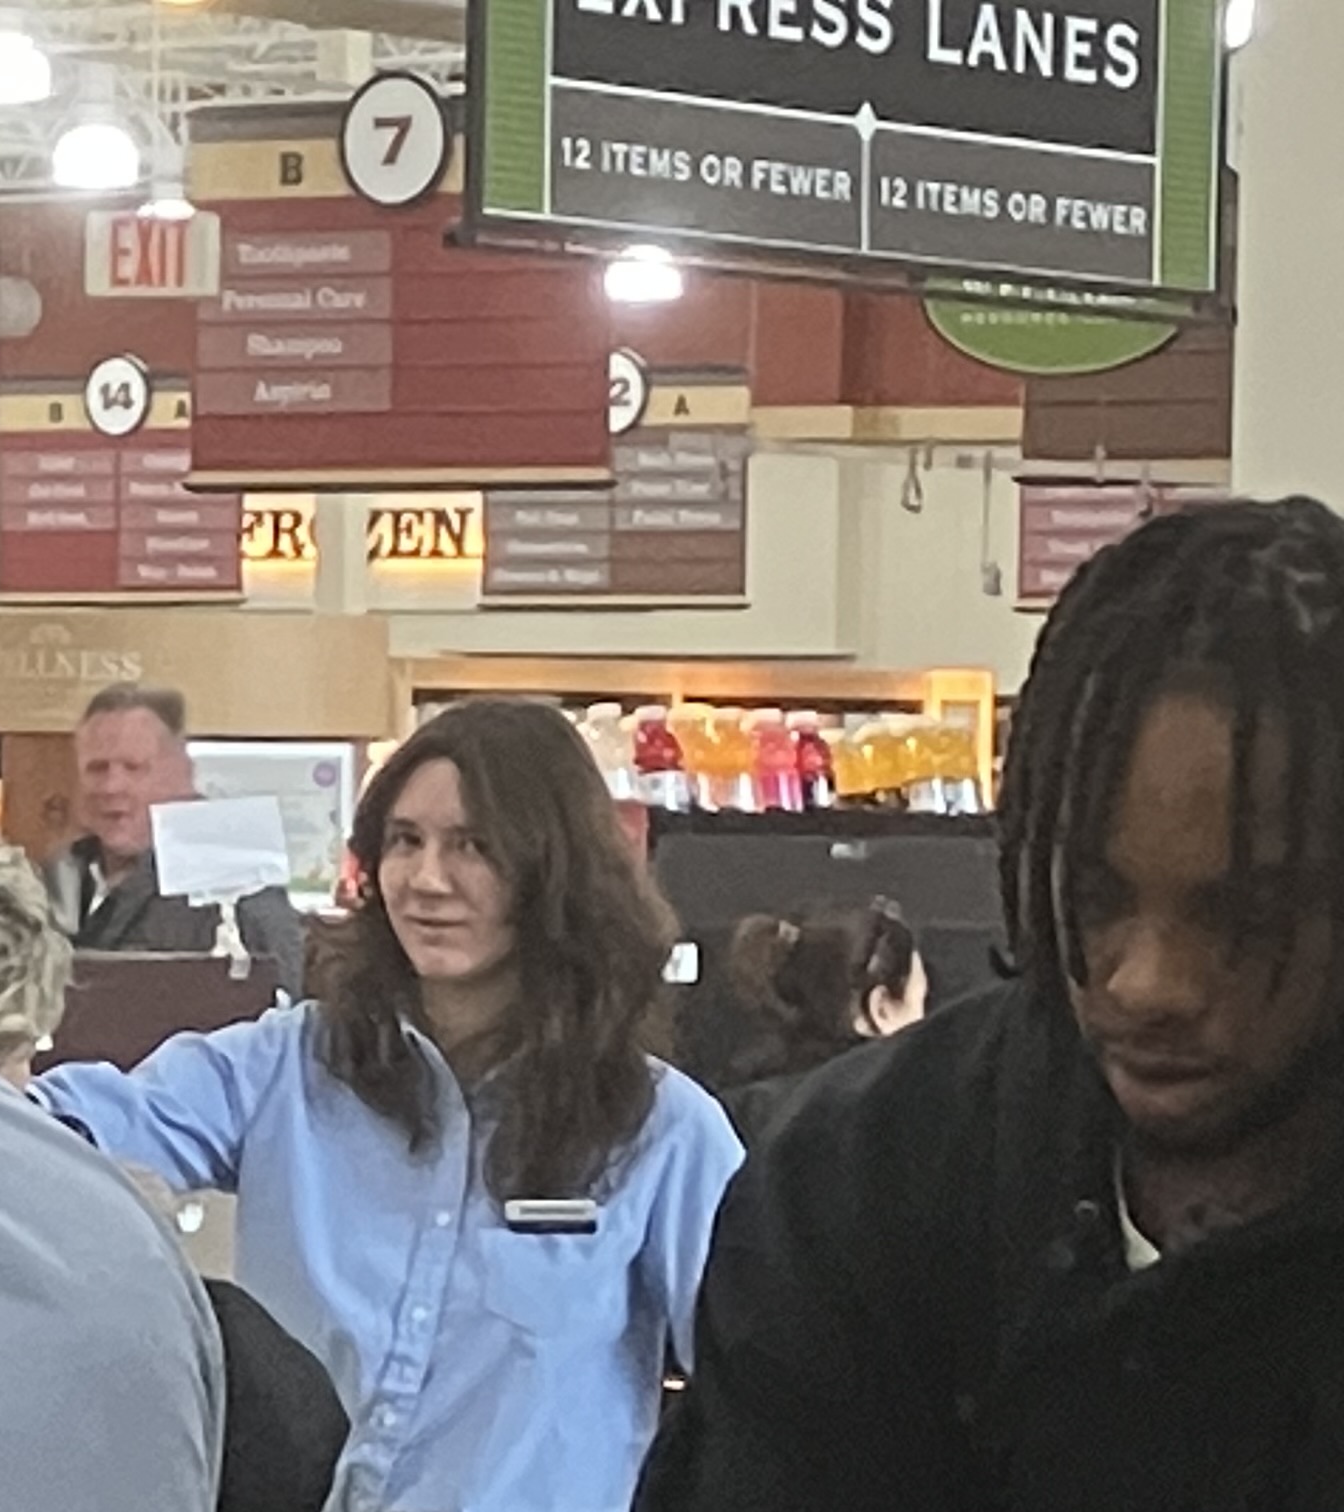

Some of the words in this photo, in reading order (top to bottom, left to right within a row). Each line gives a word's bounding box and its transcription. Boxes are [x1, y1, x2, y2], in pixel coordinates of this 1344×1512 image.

[577, 0, 893, 54] RESS
[927, 0, 1140, 88] LANES
[279, 151, 303, 186] B
[373, 115, 413, 166] 7
[561, 137, 591, 169] 12
[601, 140, 690, 181] ITEMS
[700, 154, 743, 188] OR
[750, 159, 851, 201] FEWER
[880, 176, 907, 208] 12
[916, 180, 1000, 218] ITEMS
[1007, 191, 1047, 224] OR
[1056, 196, 1147, 235] FEWER
[110, 218, 189, 288] EXIT
[100, 382, 135, 411] 14
[609, 377, 632, 406] 2
[674, 395, 690, 416] A
